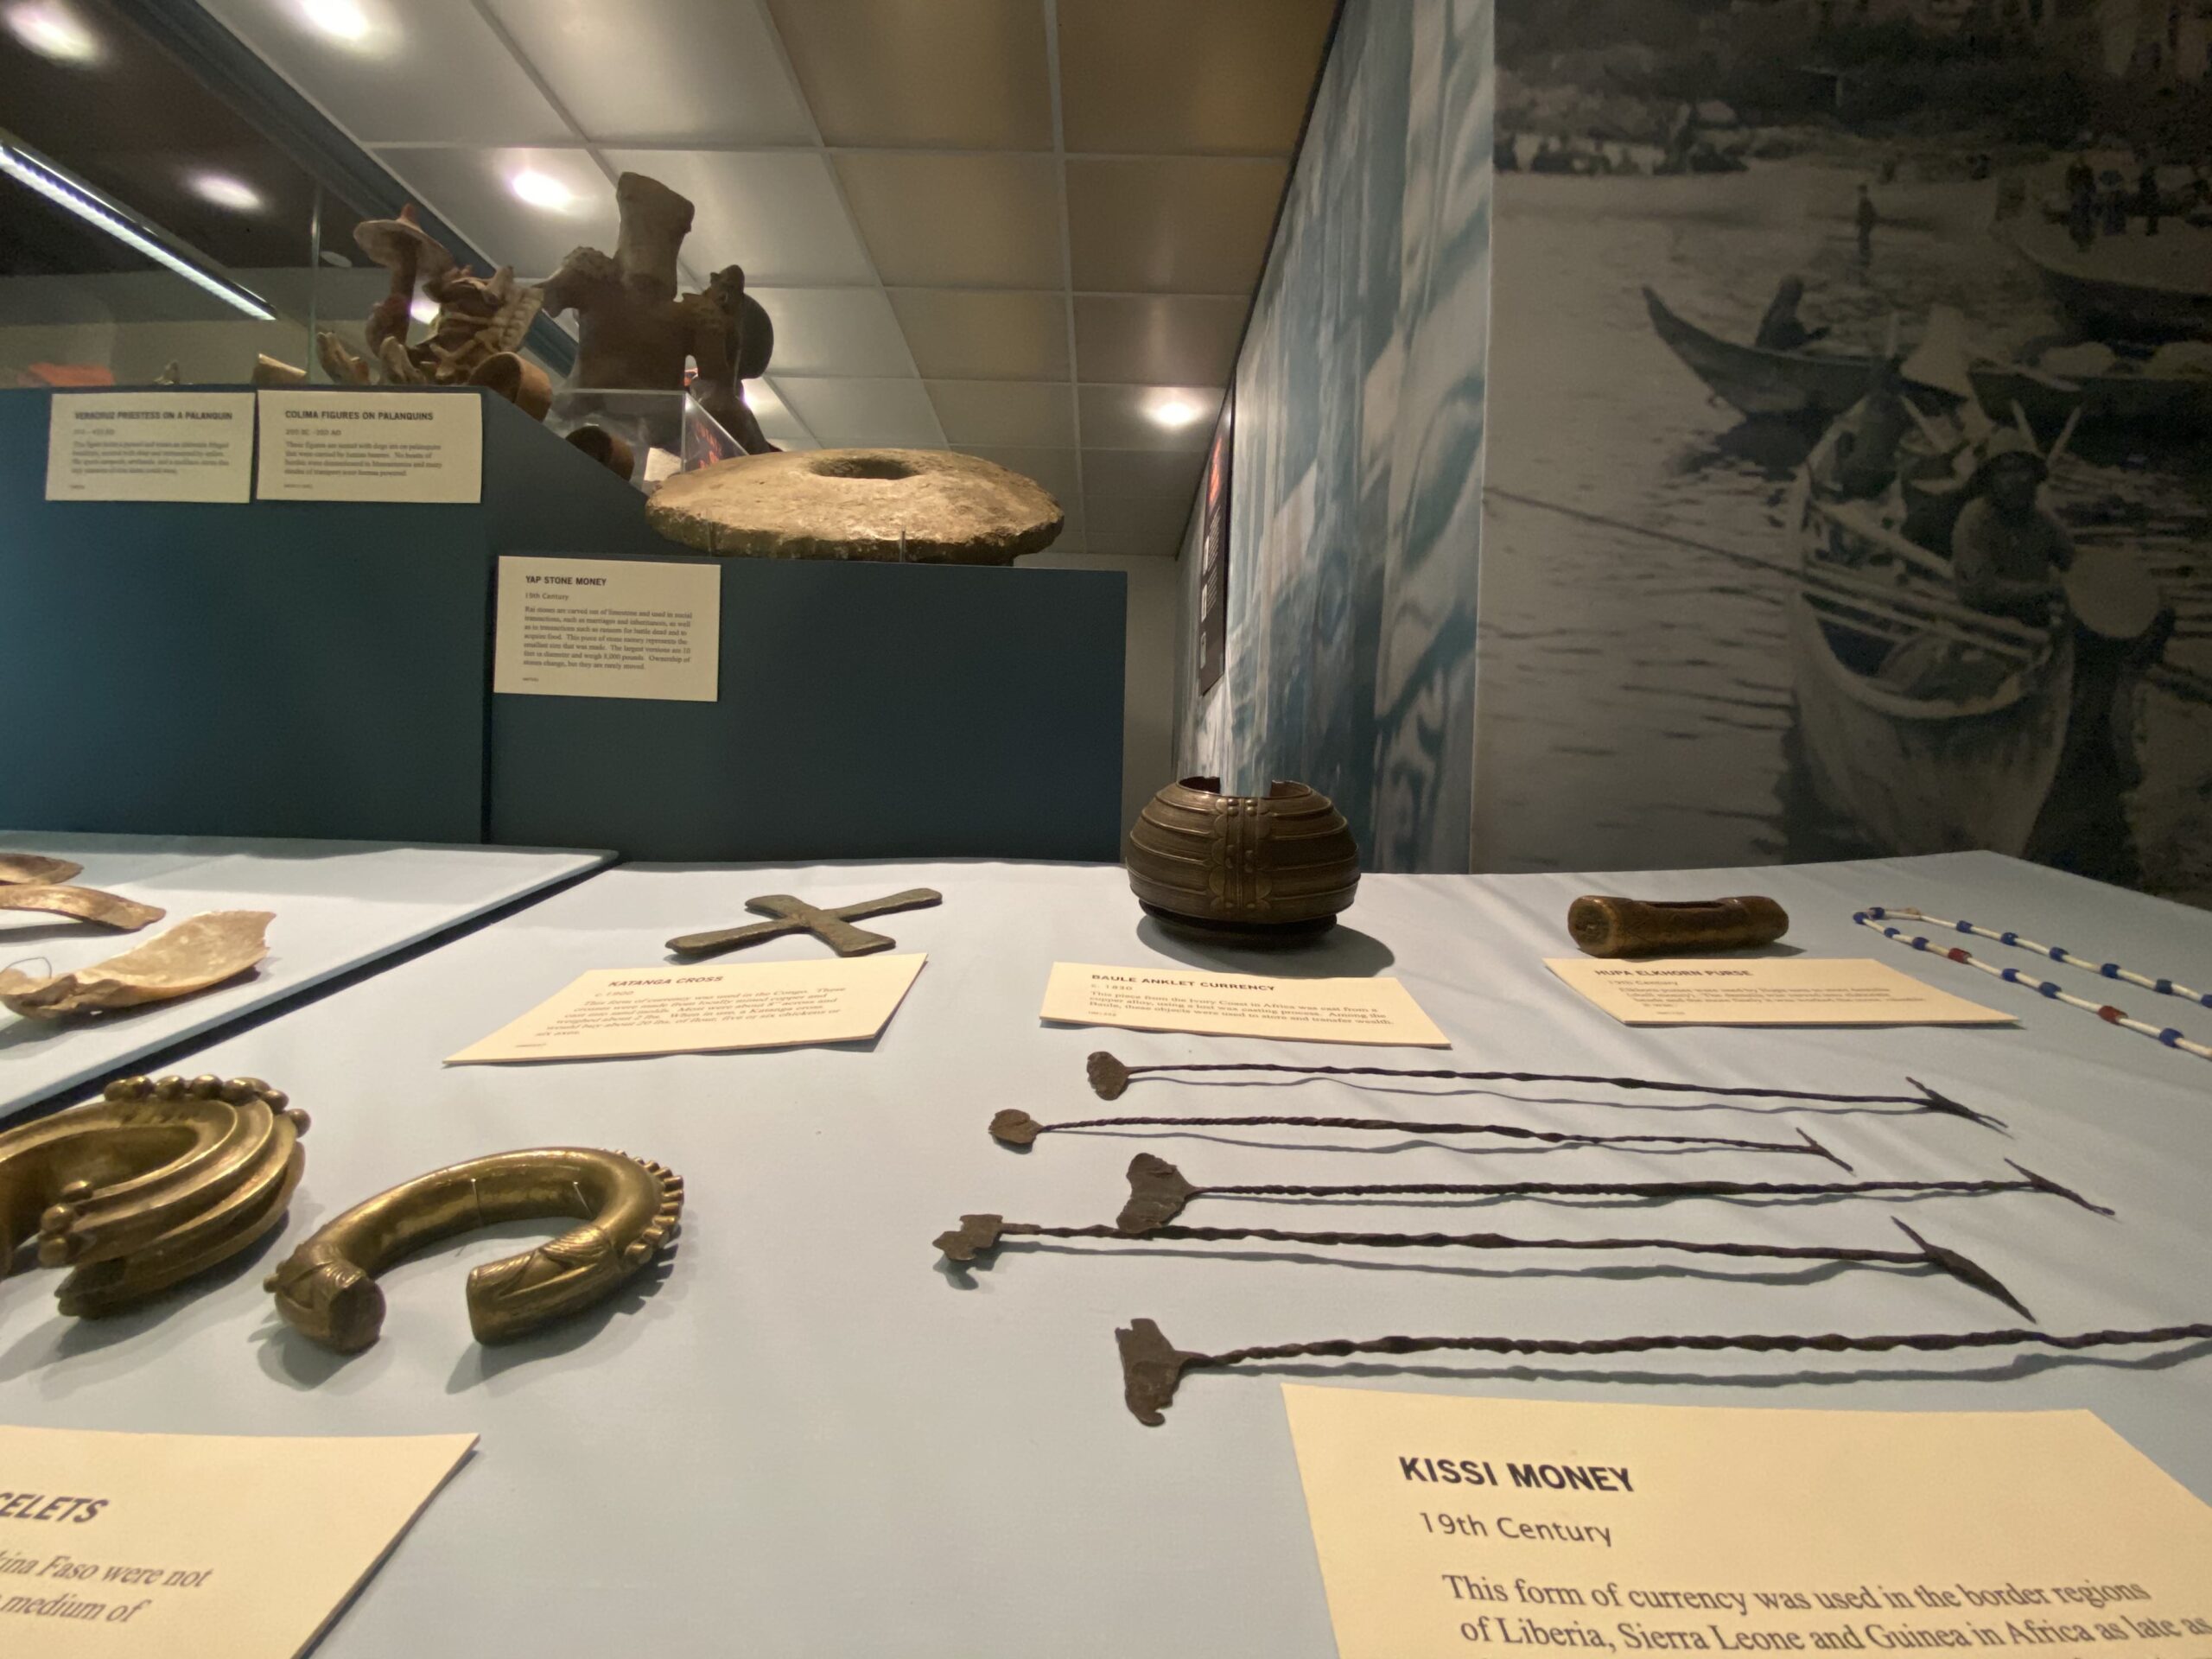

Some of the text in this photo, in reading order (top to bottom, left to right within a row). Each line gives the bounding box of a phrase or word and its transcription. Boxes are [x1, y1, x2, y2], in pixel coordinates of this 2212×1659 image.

[284, 410, 318, 418] COLIMA
[321, 410, 359, 419] FIGURES
[378, 411, 433, 420] PALANQUINS
[525, 575, 607, 586] YAP STONE MONEY
[542, 593, 569, 601] Century
[1199, 982, 1276, 991] CURRENCY
[1398, 1456, 1636, 1492] KISSI MONEY
[1420, 1512, 1612, 1548] 19th Century
[35, 1555, 99, 1580] Faso
[102, 1565, 164, 1585] were
[162, 1568, 214, 1587] not
[0, 1592, 152, 1623] medium of
[1441, 1574, 2152, 1616] This form of currency was used in the border regions
[1460, 1614, 2212, 1652] of Liberia, Sierra Leone and Guinea in Africa as late as
